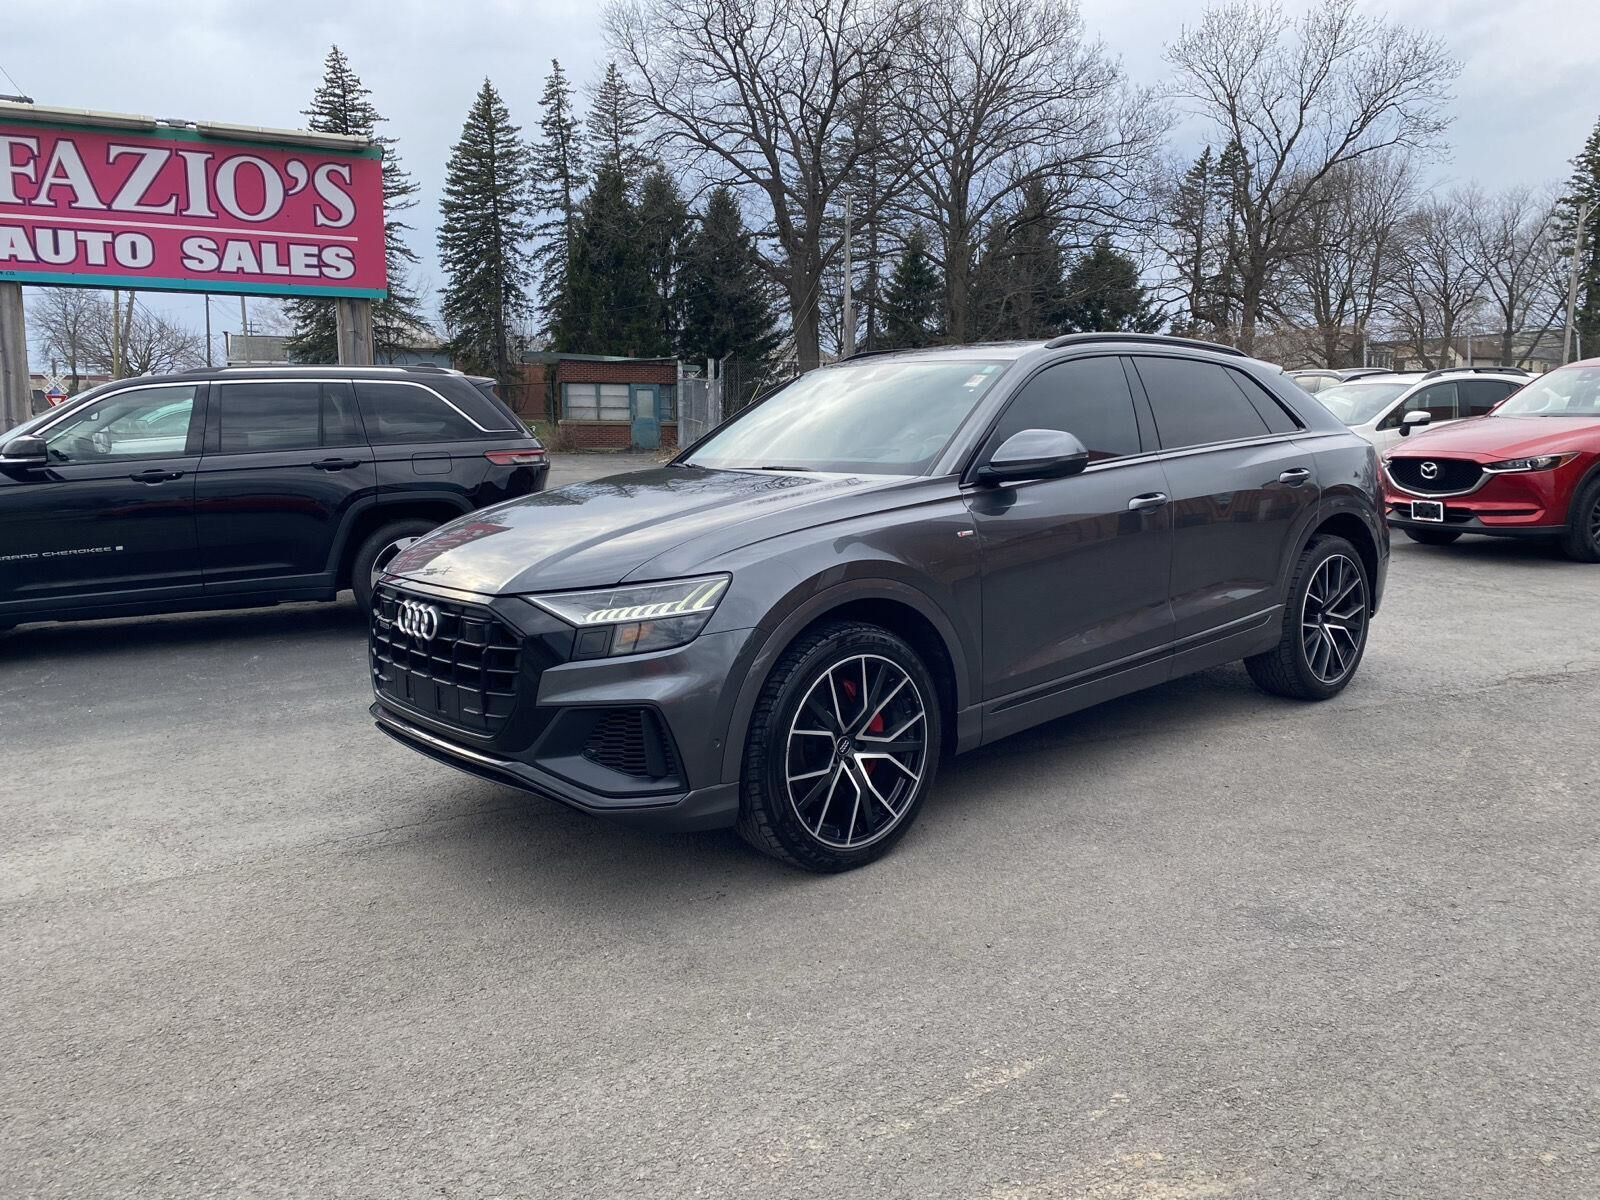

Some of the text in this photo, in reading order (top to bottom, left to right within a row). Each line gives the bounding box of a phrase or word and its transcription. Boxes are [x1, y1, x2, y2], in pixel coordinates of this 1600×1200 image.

[0, 224, 357, 280] AUTO SALES
[0, 546, 112, 561] RAND CHEROKEE
